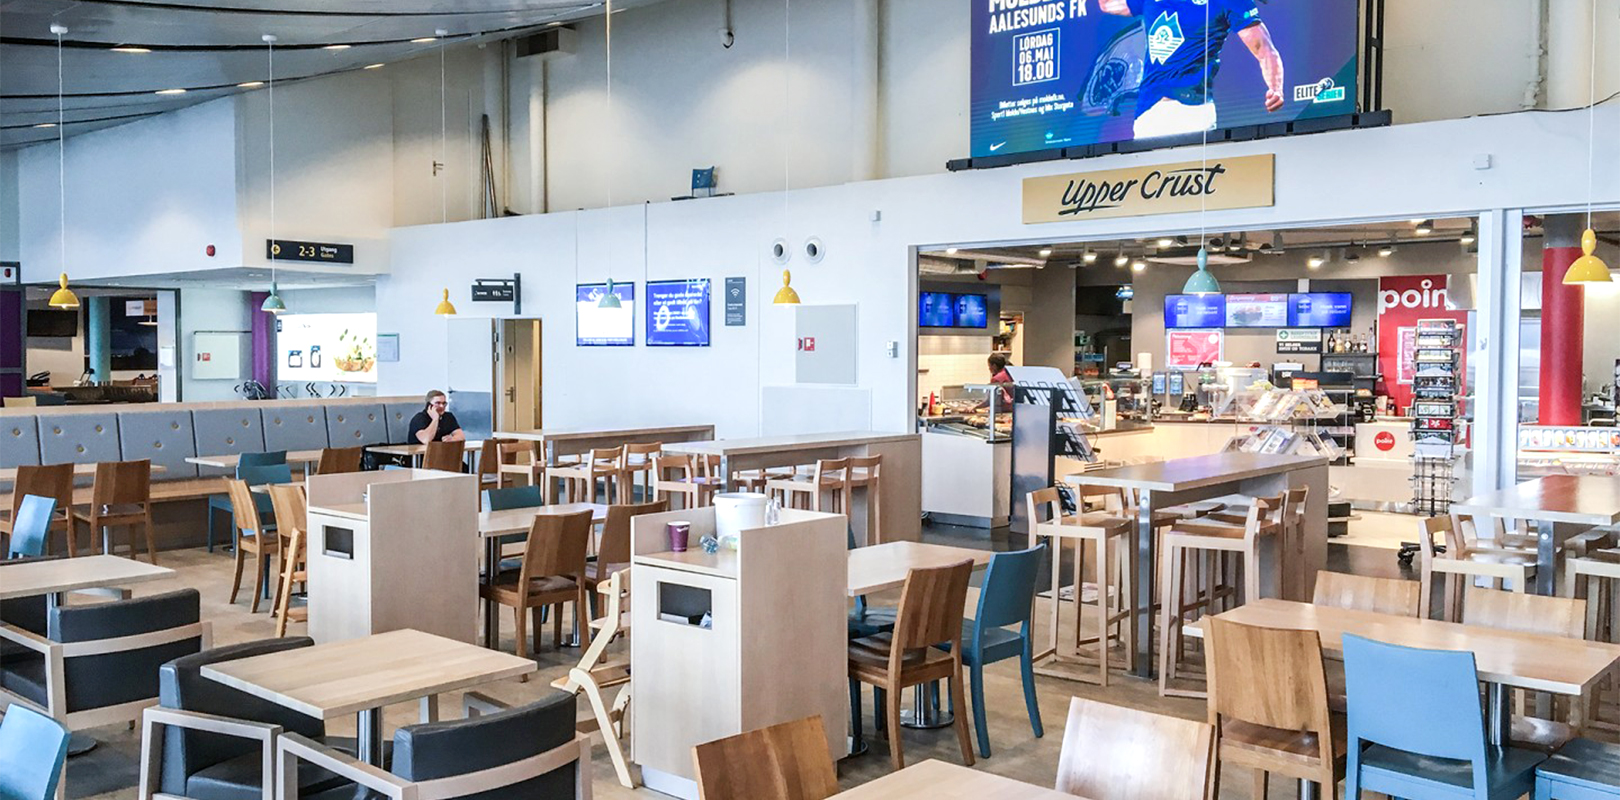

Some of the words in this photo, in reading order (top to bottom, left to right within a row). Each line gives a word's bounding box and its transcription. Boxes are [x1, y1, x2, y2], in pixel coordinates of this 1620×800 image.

[989, 2, 1065, 34] AALESUNDS
[1069, 0, 1087, 19] FK
[1019, 33, 1054, 51] LØRDAG
[1019, 46, 1054, 64] 06.MAI
[1018, 60, 1054, 83] 18.00
[1296, 86, 1318, 99] ELITE
[1058, 179, 1138, 215] Upper
[1140, 163, 1226, 199] Crust
[299, 246, 315, 257] 2-3
[1379, 279, 1447, 315] poin
